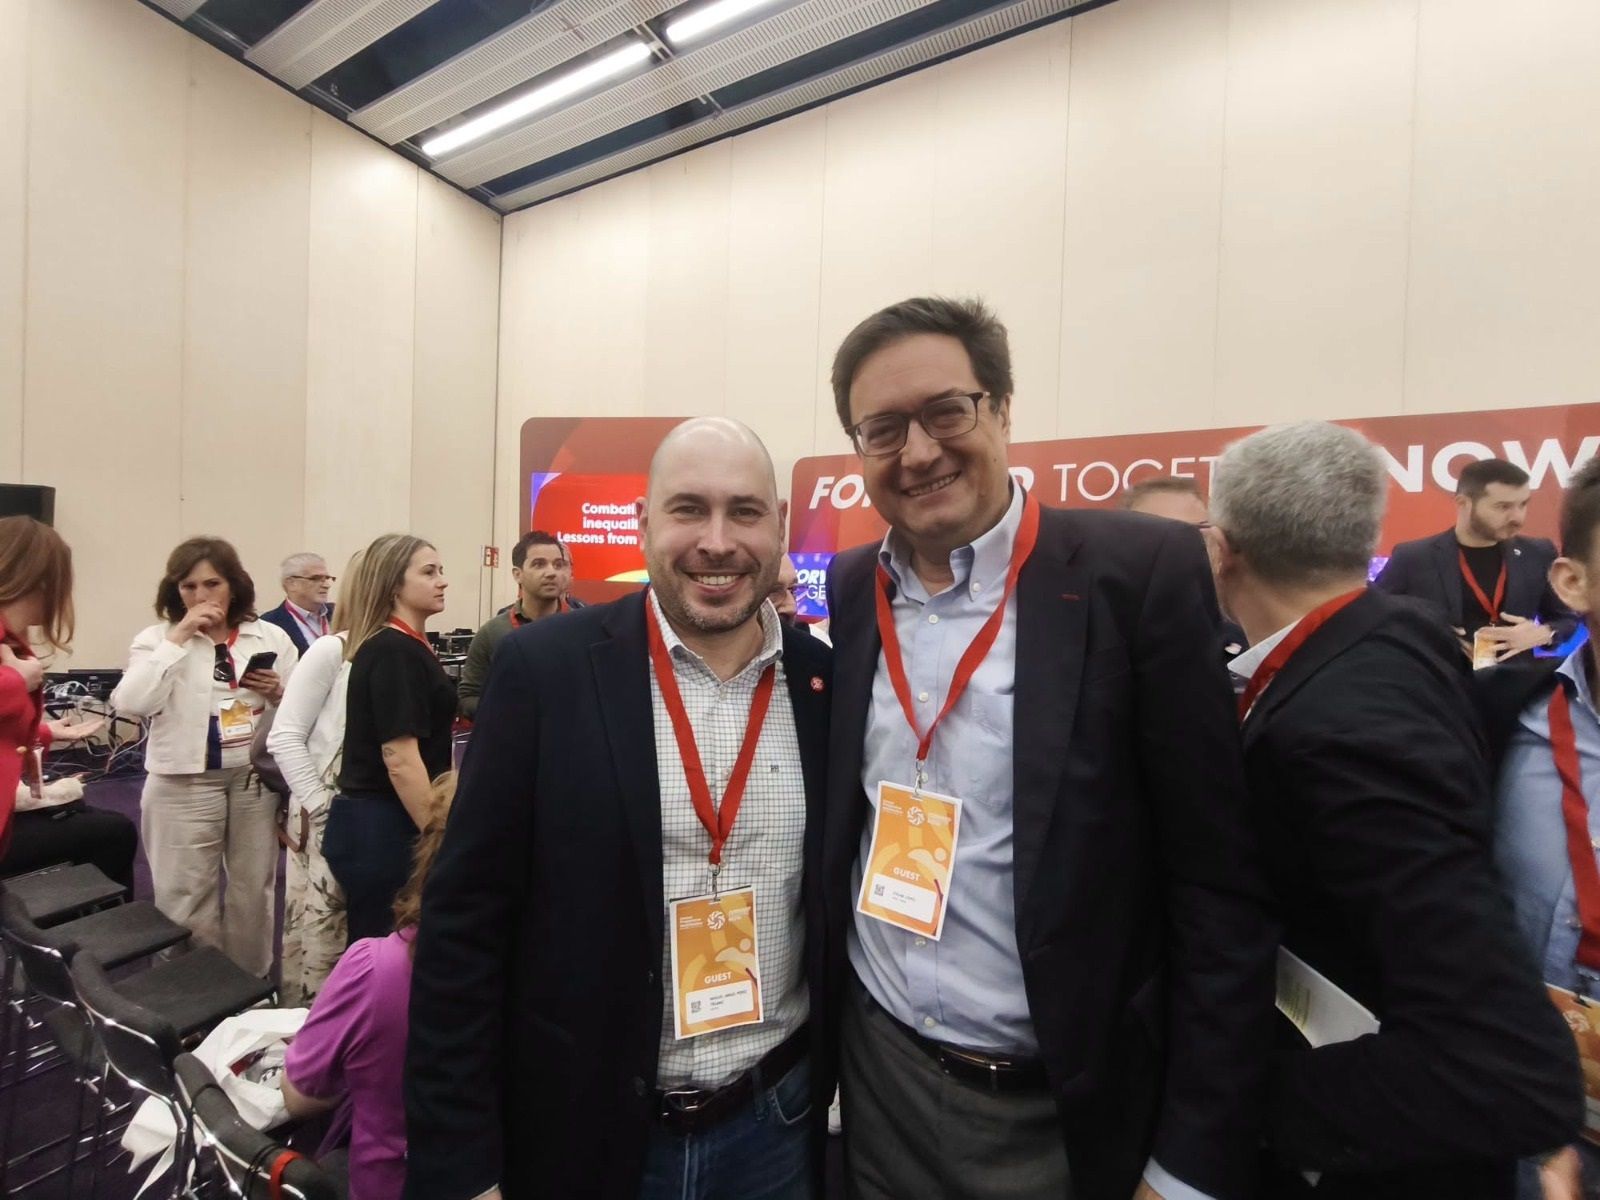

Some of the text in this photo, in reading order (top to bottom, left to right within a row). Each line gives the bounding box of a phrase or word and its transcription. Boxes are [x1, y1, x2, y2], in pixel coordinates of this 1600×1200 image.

[557, 531, 638, 545] Lessons from
[892, 866, 921, 882] GUEST
[704, 971, 732, 984] GUEST
